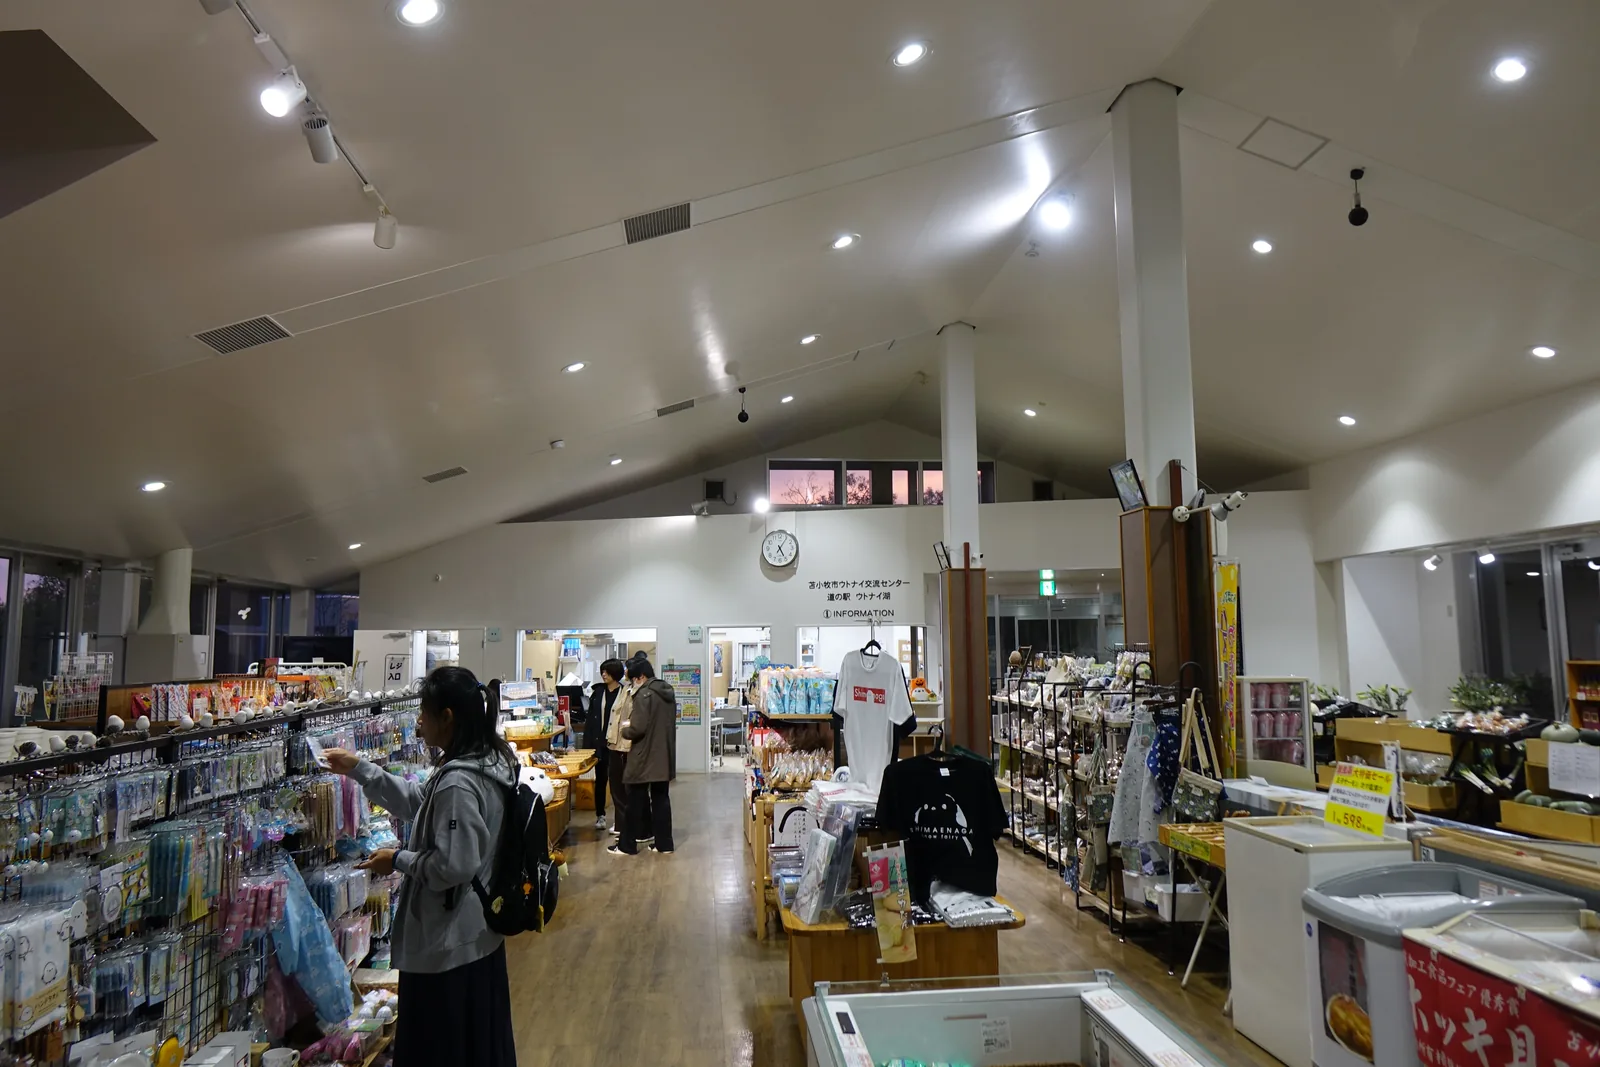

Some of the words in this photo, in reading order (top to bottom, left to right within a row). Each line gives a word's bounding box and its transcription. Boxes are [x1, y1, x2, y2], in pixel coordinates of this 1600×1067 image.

[808, 579, 911, 590] 苫小牧市ウトナイ交流センター
[826, 592, 851, 601] 道の駅
[855, 591, 891, 601] ウトナイ湖
[833, 609, 894, 618] INFORMATION
[389, 662, 403, 670] レジ
[387, 672, 401, 681] 入口
[909, 826, 974, 835] SHIMAENAGA
[1407, 973, 1570, 1067] ホッキ貝
